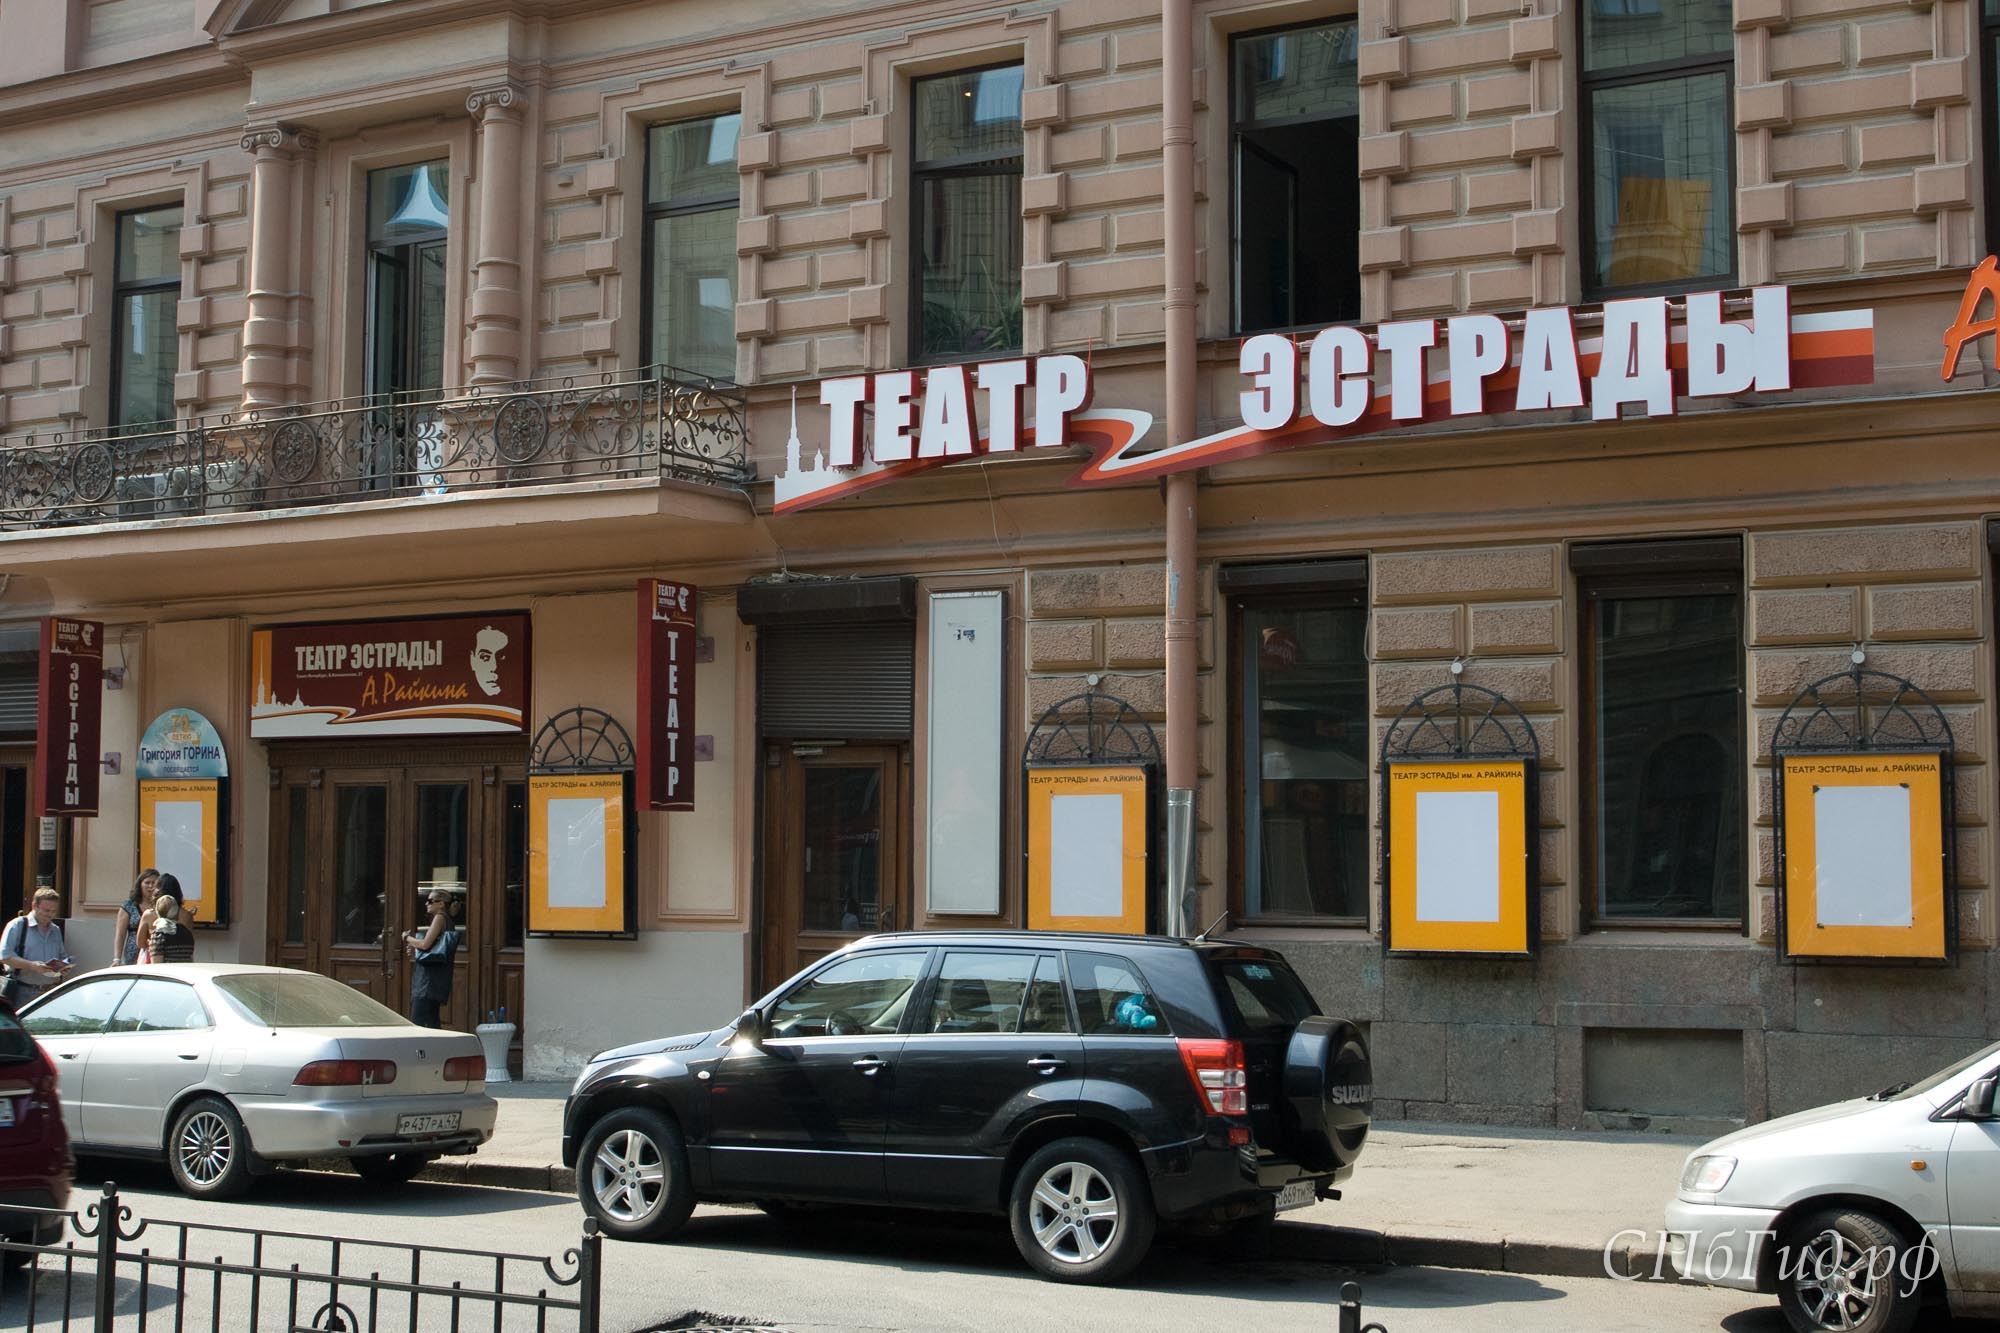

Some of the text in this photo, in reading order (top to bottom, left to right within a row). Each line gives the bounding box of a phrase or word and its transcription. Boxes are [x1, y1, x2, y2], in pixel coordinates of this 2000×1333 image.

[820, 354, 1092, 468] ТЕАТР
[1239, 285, 1793, 432] ЭСТРАДЫ
[657, 584, 676, 598] ТЕАТР
[58, 622, 80, 633] ТЕАТР
[295, 640, 443, 671] ТЕАТР ЭСТРАДЫ
[382, 671, 469, 704] Райкина
[667, 631, 679, 797] ТЕАТР
[64, 662, 80, 806] ЭСТРАДЫ
[141, 746, 221, 763] Григория ГОРИНА
[1420, 772, 1459, 780] ЭСТРАДЫ
[1476, 769, 1522, 778] А.РАЙКИНА
[1787, 766, 1815, 774] ТЕАТР
[1818, 765, 1862, 774] ЭСТРАДЫ
[1883, 763, 1936, 772] А.РАЙКИНА
[551, 781, 577, 789] ЭСТРАДЫ
[1030, 776, 1052, 784] ТЕАТР
[1054, 776, 1088, 784] ЭСТРАДЫ
[1102, 775, 1143, 783] А.РАЙКИНА
